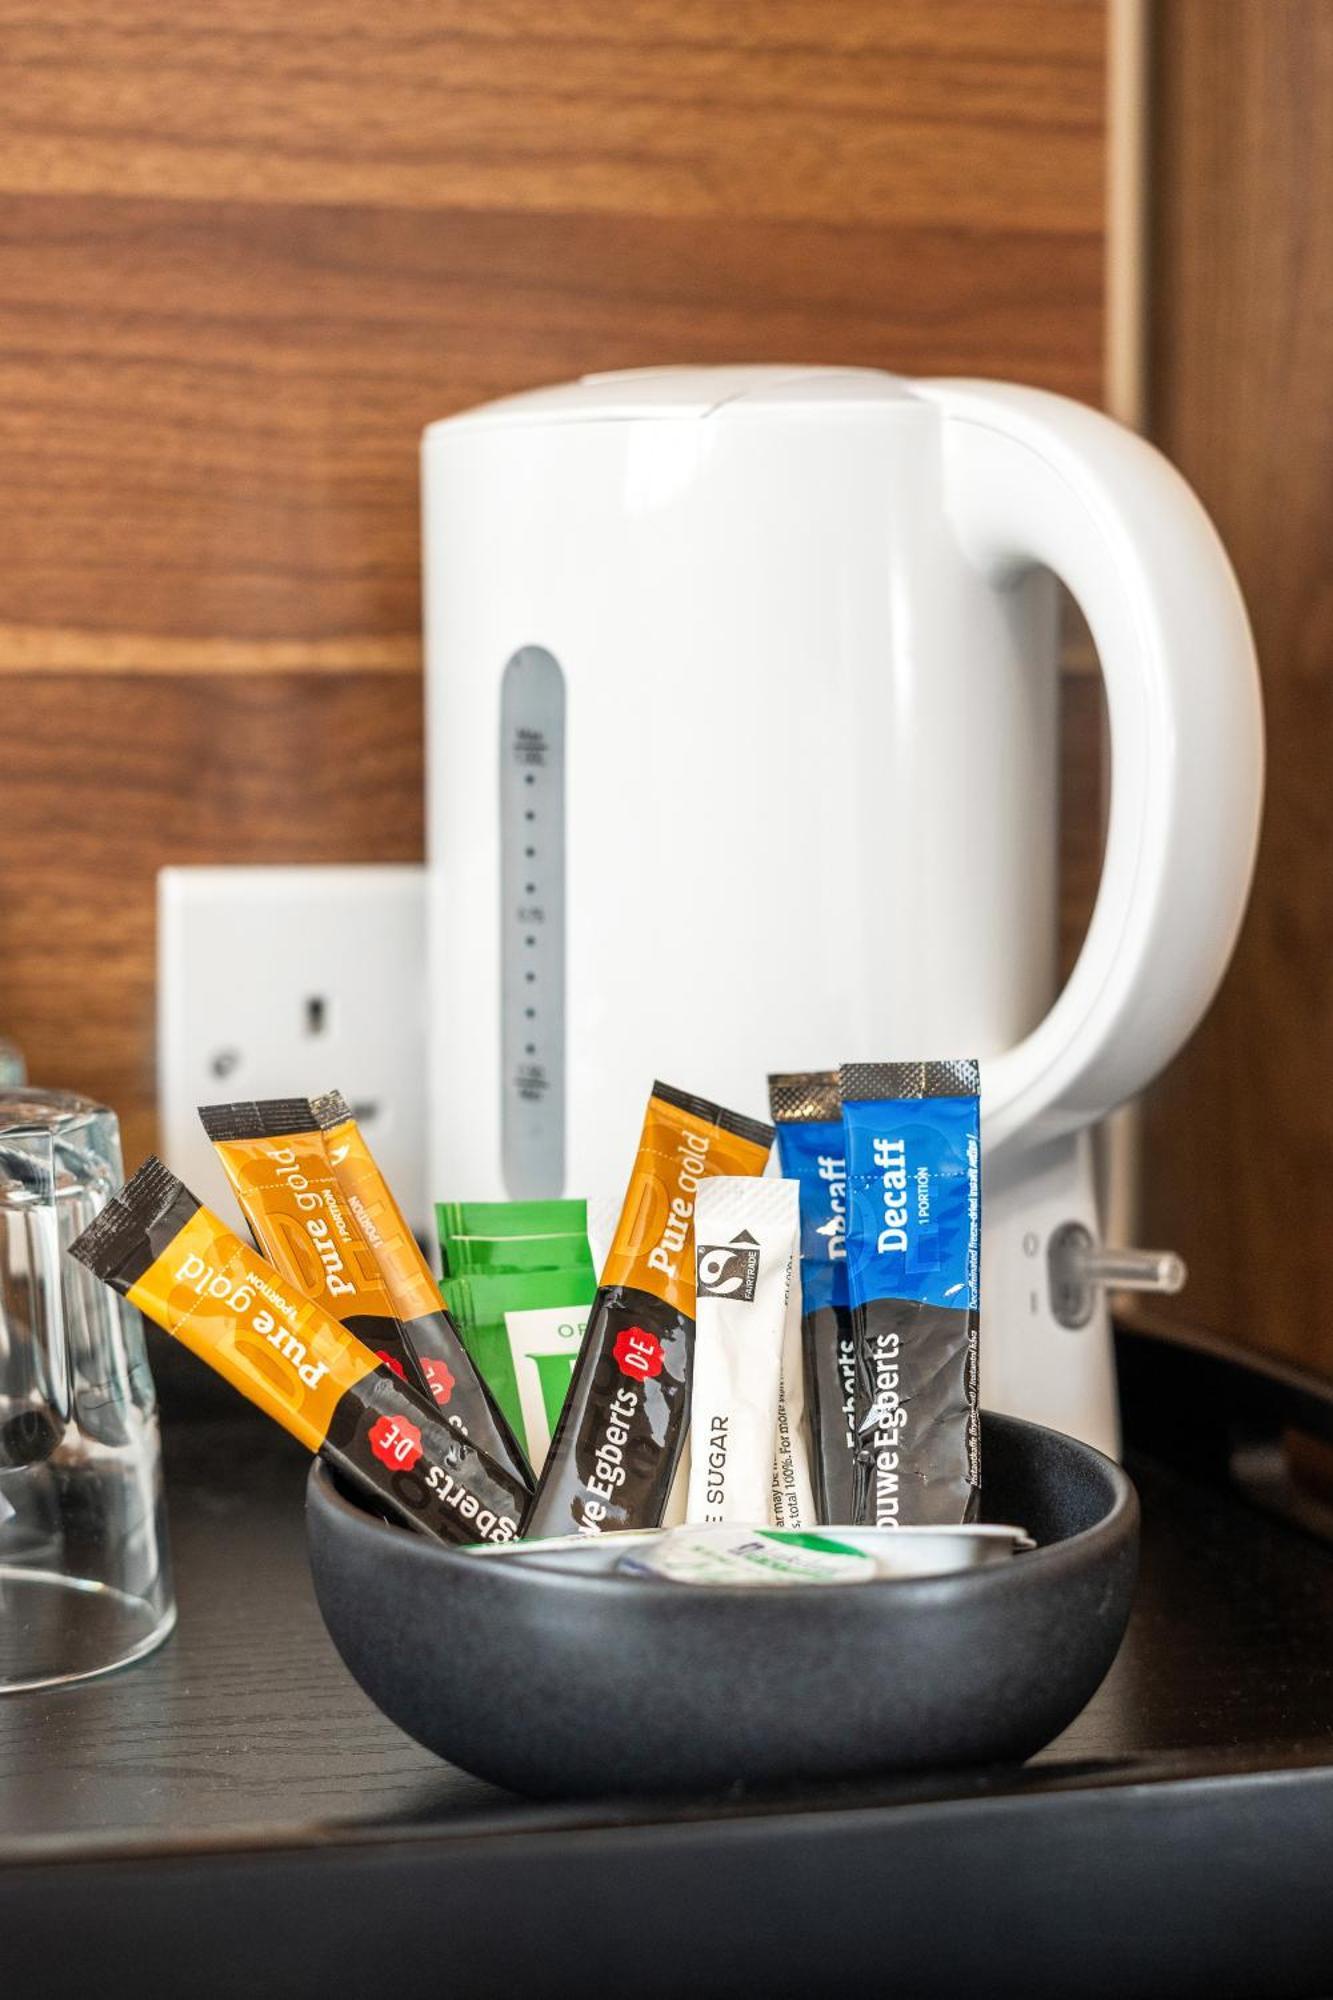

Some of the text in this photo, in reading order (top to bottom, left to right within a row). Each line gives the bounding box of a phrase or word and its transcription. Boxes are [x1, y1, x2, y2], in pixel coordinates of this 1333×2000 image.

[266, 1148, 357, 1298] Pure gold
[322, 1189, 350, 1238] PORTION
[347, 1195, 381, 1243] PORTION
[647, 1130, 709, 1279] Pure gold
[873, 1138, 908, 1254] Decaff
[917, 1167, 930, 1225] 1 PORTION
[245, 1272, 295, 1313] PORTION
[745, 1251, 757, 1299] FAIRTRADE
[175, 1252, 330, 1390] Pure gold
[873, 1332, 908, 1447] Egberts
[587, 1388, 638, 1500] Egberts
[706, 1416, 729, 1504] SUGAR
[779, 1436, 791, 1455] For
[425, 1465, 521, 1544] gberts
[772, 1489, 783, 1515] may
[786, 1491, 800, 1519] total
